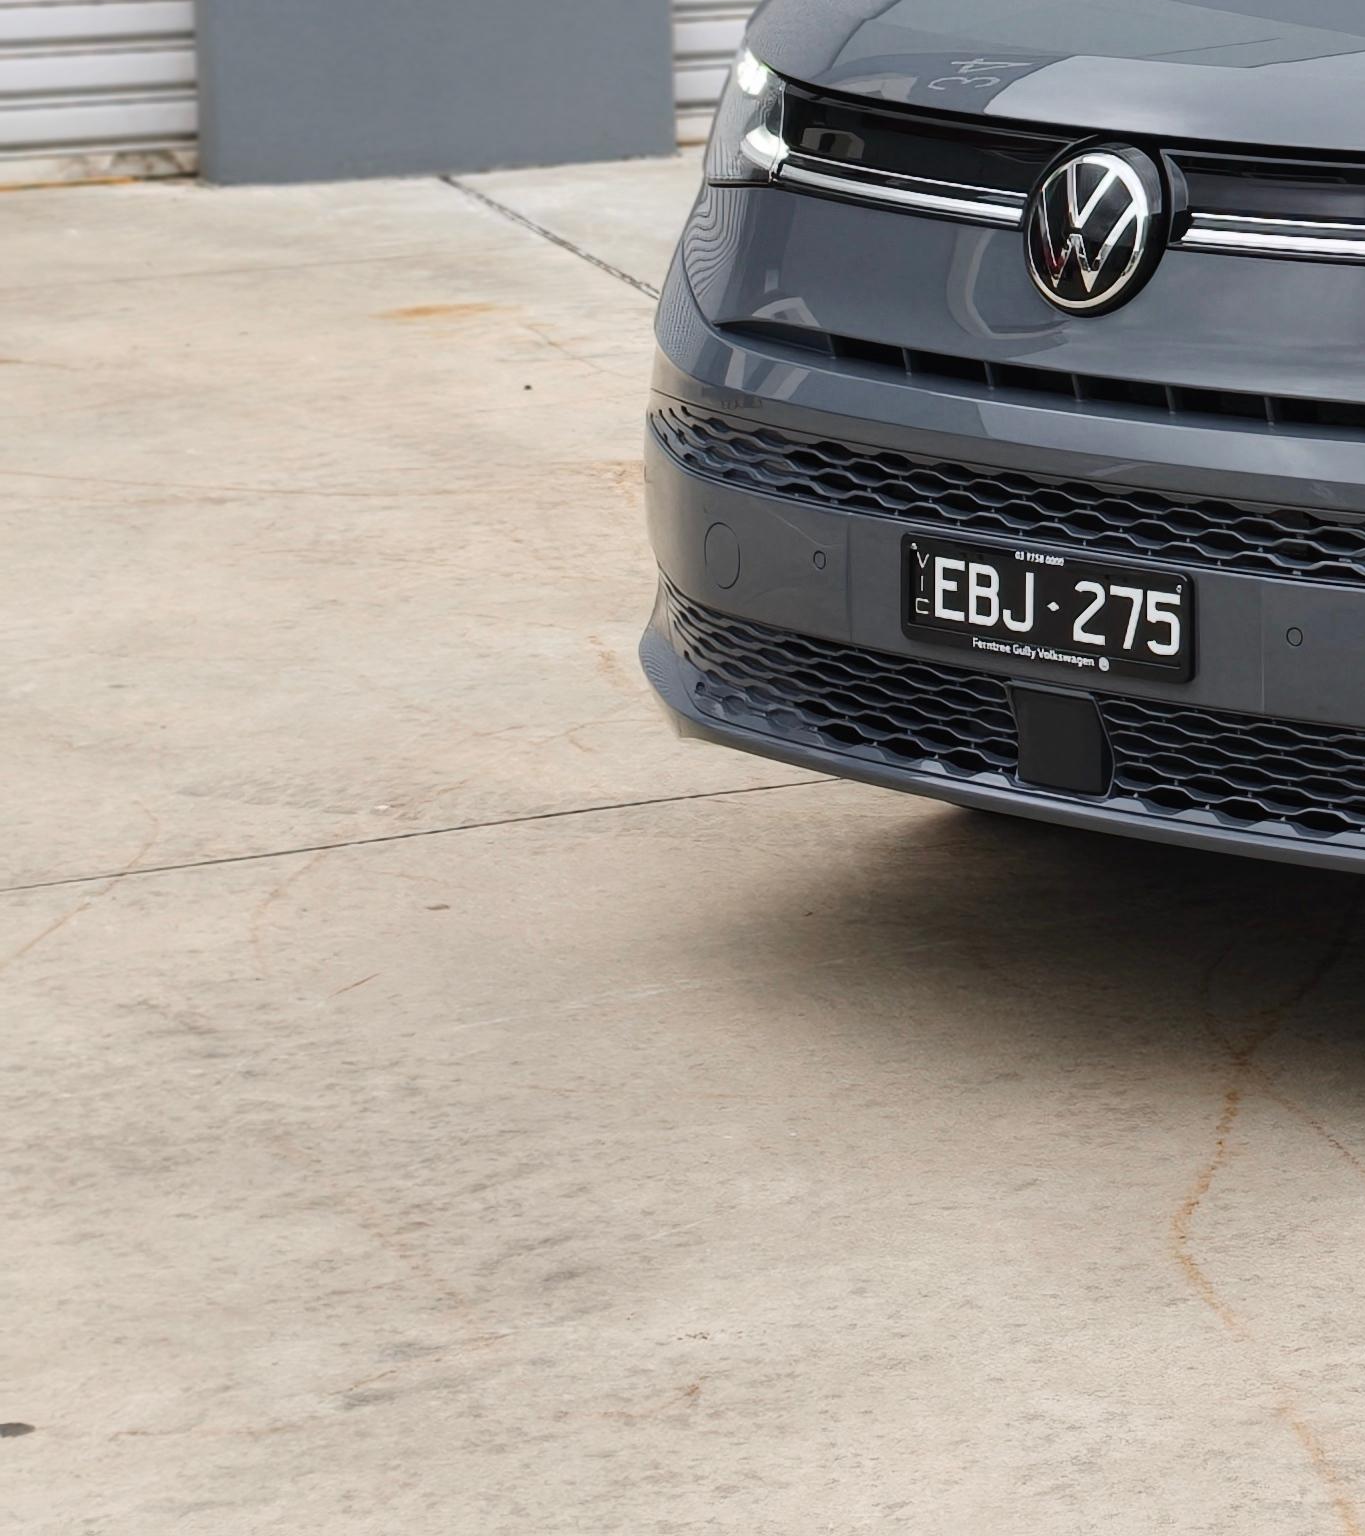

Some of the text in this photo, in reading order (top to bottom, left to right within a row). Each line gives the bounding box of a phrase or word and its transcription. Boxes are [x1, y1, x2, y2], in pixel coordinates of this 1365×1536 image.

[916, 552, 929, 614] VIC
[934, 556, 1181, 656] EBJ 275
[972, 637, 1095, 667] Ferntree Gully Volkswagen
